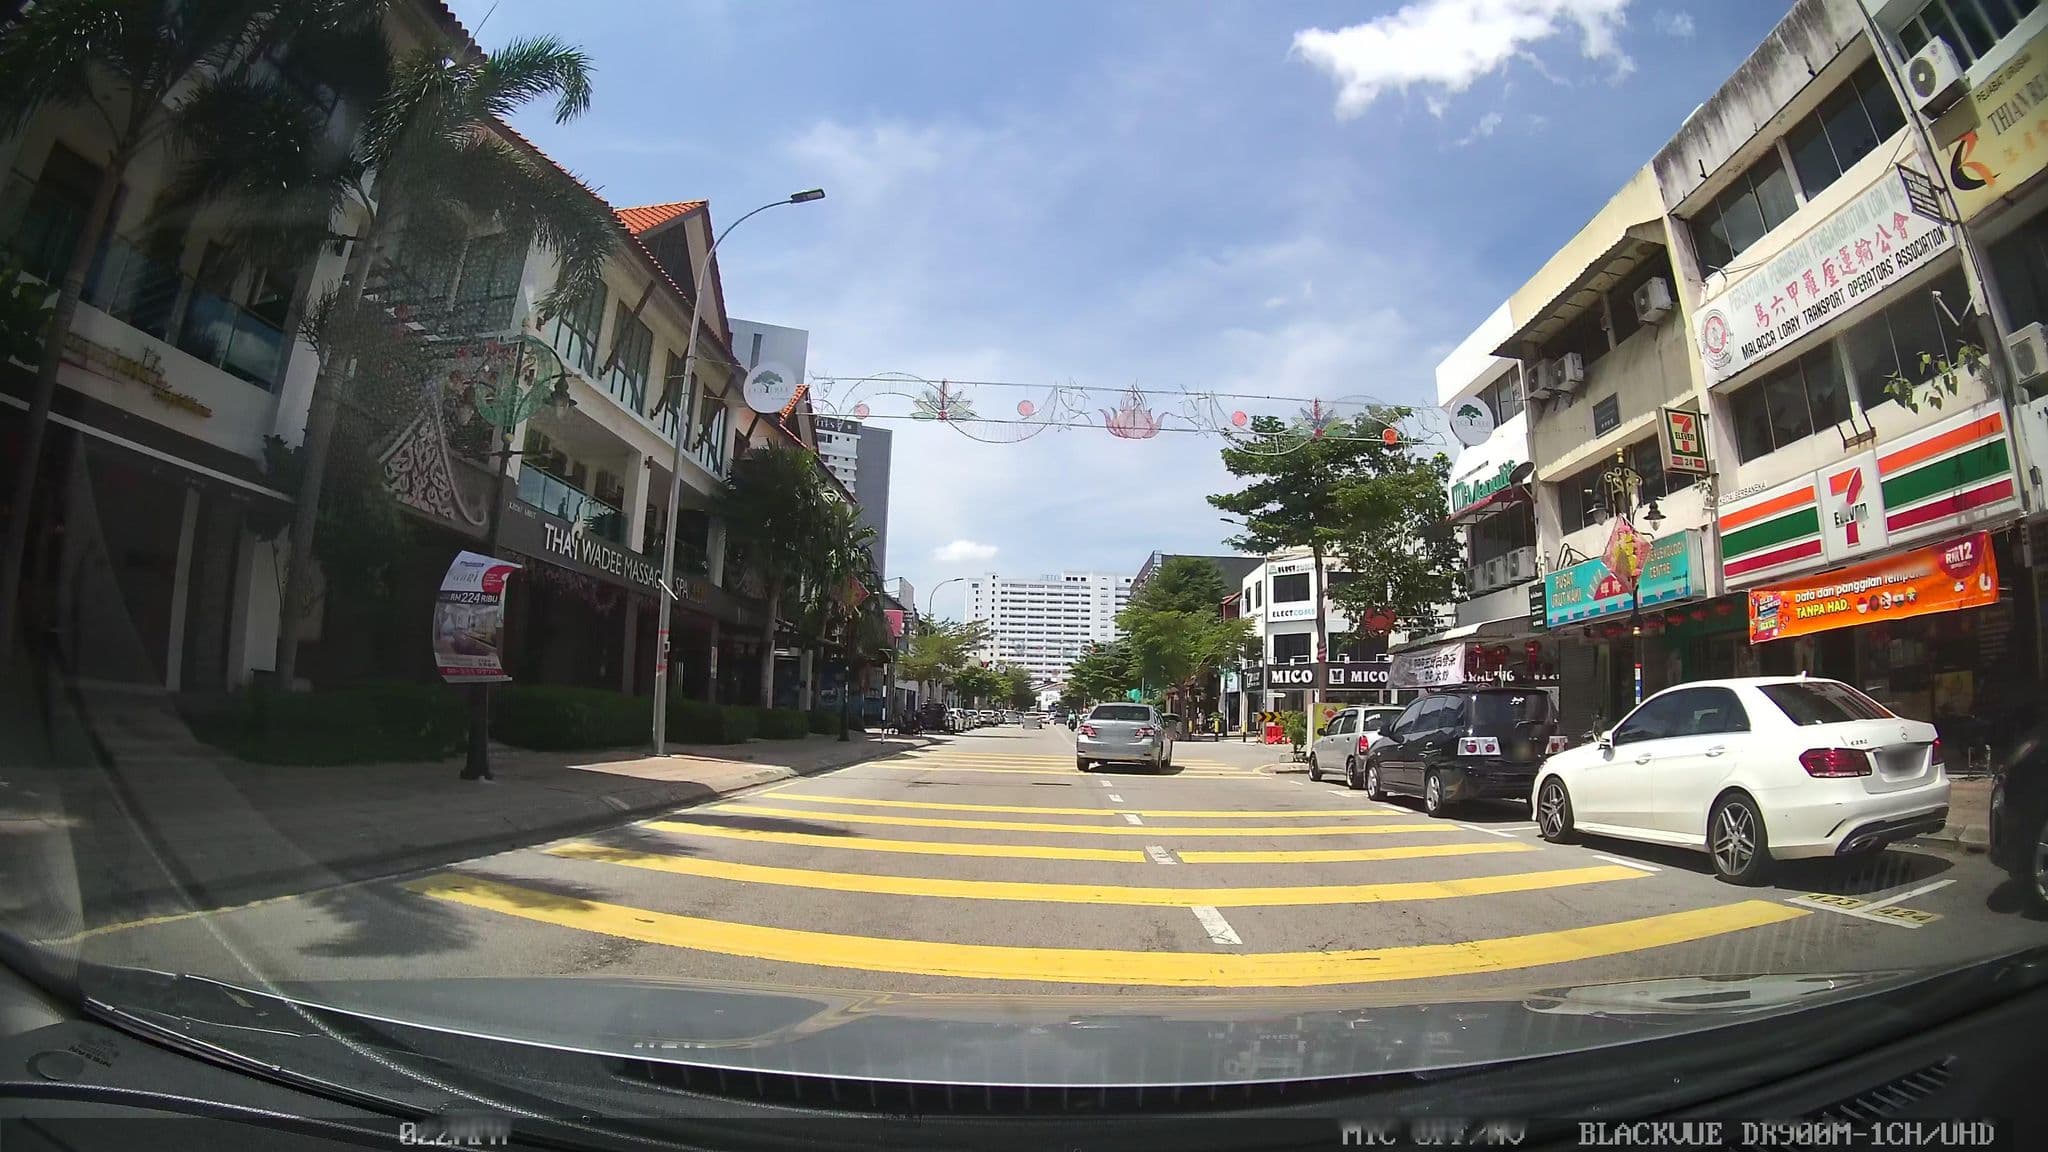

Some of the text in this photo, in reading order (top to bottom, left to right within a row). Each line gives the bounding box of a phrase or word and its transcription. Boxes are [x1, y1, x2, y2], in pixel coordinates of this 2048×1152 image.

[1741, 329, 1777, 361] MALACCA
[1777, 314, 1801, 341] LORRY
[1802, 288, 1846, 326] TRANSPORT
[1895, 225, 1947, 270] ASSOCIATION
[1684, 458, 1693, 467] 24
[544, 517, 689, 600] THAI WADEE MASSAG SPA
[1650, 562, 1671, 579] CENTRE
[1555, 571, 1574, 588] PUSAT
[461, 592, 481, 604] 224
[1795, 590, 1816, 604] Data
[1817, 586, 1835, 599] dan
[1836, 575, 1882, 596] panggilan
[1796, 601, 1825, 620] TANPA
[1271, 670, 1313, 683] MICO
[1351, 670, 1389, 683] MICO
